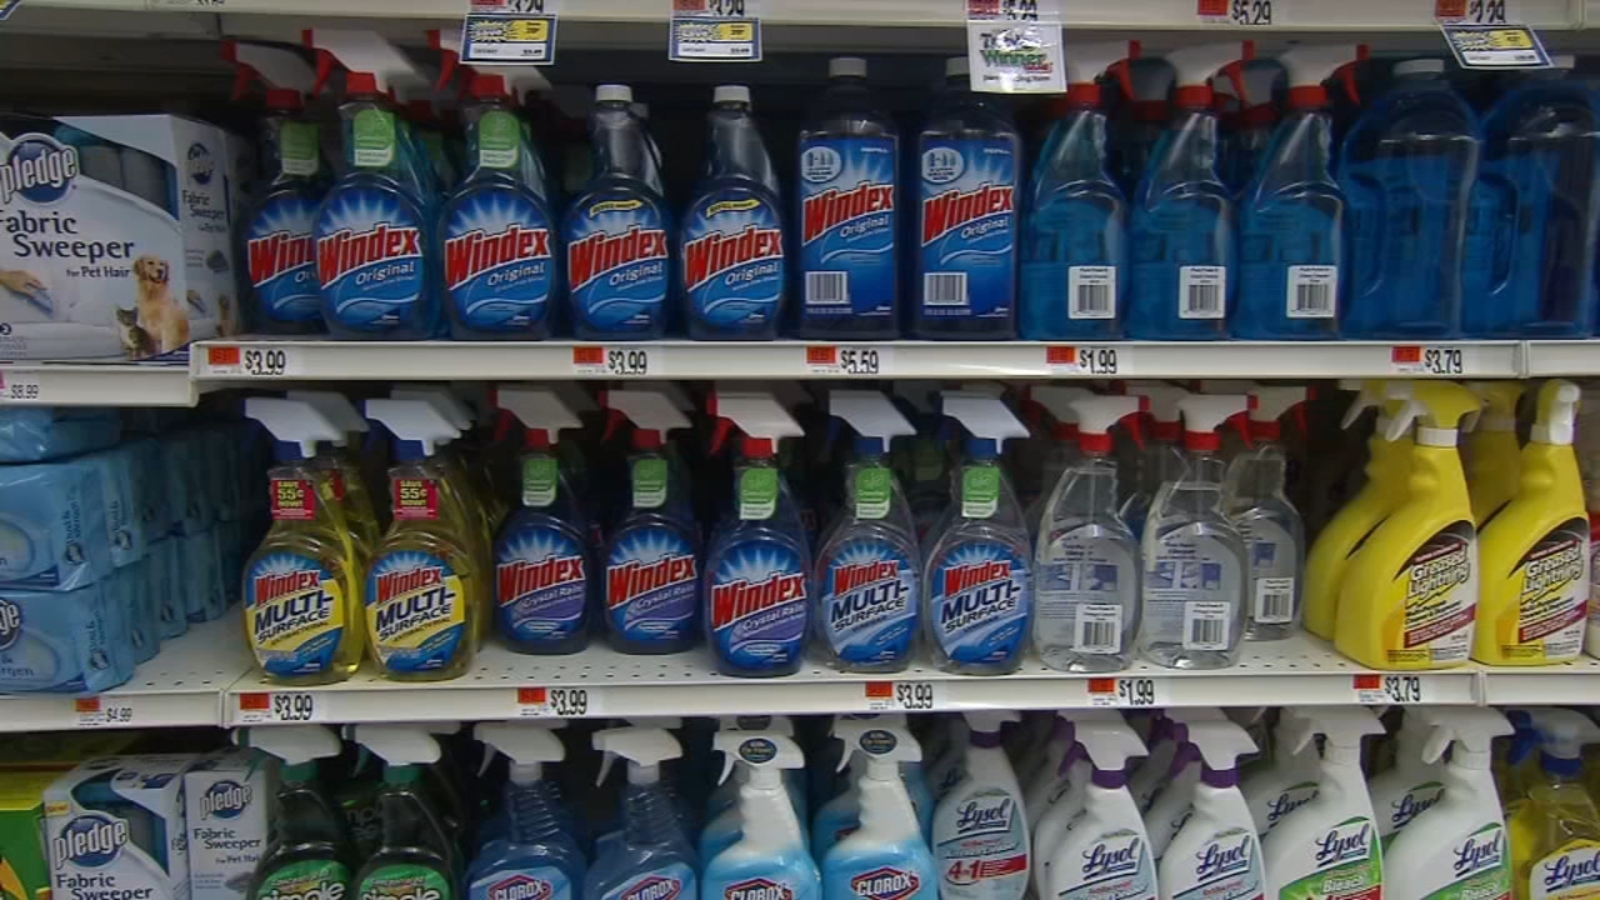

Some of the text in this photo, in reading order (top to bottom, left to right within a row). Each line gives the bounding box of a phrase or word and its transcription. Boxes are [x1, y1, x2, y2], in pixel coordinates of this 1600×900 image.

[1231, 0, 1272, 25] $5.29
[0, 148, 77, 202] pledge
[802, 183, 894, 247] Windex
[840, 215, 889, 237] Original
[921, 184, 1014, 247] Windex
[961, 217, 1009, 239] Original
[13, 234, 135, 263] Sweeper
[248, 231, 314, 287] Win
[317, 223, 422, 289] Windex
[445, 225, 552, 290] Windex
[568, 226, 668, 292] Windex
[684, 226, 784, 292] Windex
[81, 266, 101, 278] Pet
[104, 266, 130, 278] Hair
[355, 261, 415, 286] Original
[487, 262, 545, 287] Original
[609, 262, 663, 285] Original
[725, 263, 778, 286] Original
[245, 350, 286, 376] $3.99
[608, 350, 647, 375] $3.99
[840, 350, 879, 374] $5.59
[1079, 350, 1117, 374] $1.99
[1425, 350, 1462, 374] $3.79
[255, 570, 320, 606] Windex
[377, 566, 442, 603] Windex
[498, 555, 586, 607] Windex
[607, 555, 697, 609] Windex
[834, 560, 899, 598] Windex
[944, 560, 1012, 599] Windex
[254, 592, 333, 633] MULTI-
[375, 588, 455, 631] MULTI-
[712, 572, 806, 632] Windex
[831, 580, 909, 623] MULTI-
[835, 597, 906, 632] SURFACE
[941, 579, 1020, 624] MULTI-
[945, 597, 1016, 633] SURFACE
[258, 608, 330, 644] SURFACE
[379, 604, 452, 640] SURFACE
[550, 690, 588, 715] $3.99
[897, 684, 933, 709] $3.99
[1119, 679, 1154, 705] $1.99
[1385, 677, 1421, 702] $3.79
[106, 707, 132, 723] $4.99
[275, 695, 313, 721] $3.99
[200, 784, 252, 820] pledge
[956, 799, 1010, 829] Lysol
[53, 820, 127, 871] pledge
[193, 828, 237, 840] Fabric
[204, 838, 261, 851] Sweeper
[1316, 823, 1370, 862] Lysol
[1454, 830, 1501, 871] Lysol
[1082, 836, 1140, 872] Lysol
[1196, 834, 1250, 874] Lysol
[1545, 850, 1600, 886] Lysol
[56, 873, 116, 888] Fabric
[71, 887, 153, 900] Sweeper
[494, 880, 544, 900] CLOROX
[857, 872, 912, 896] CLOROX
